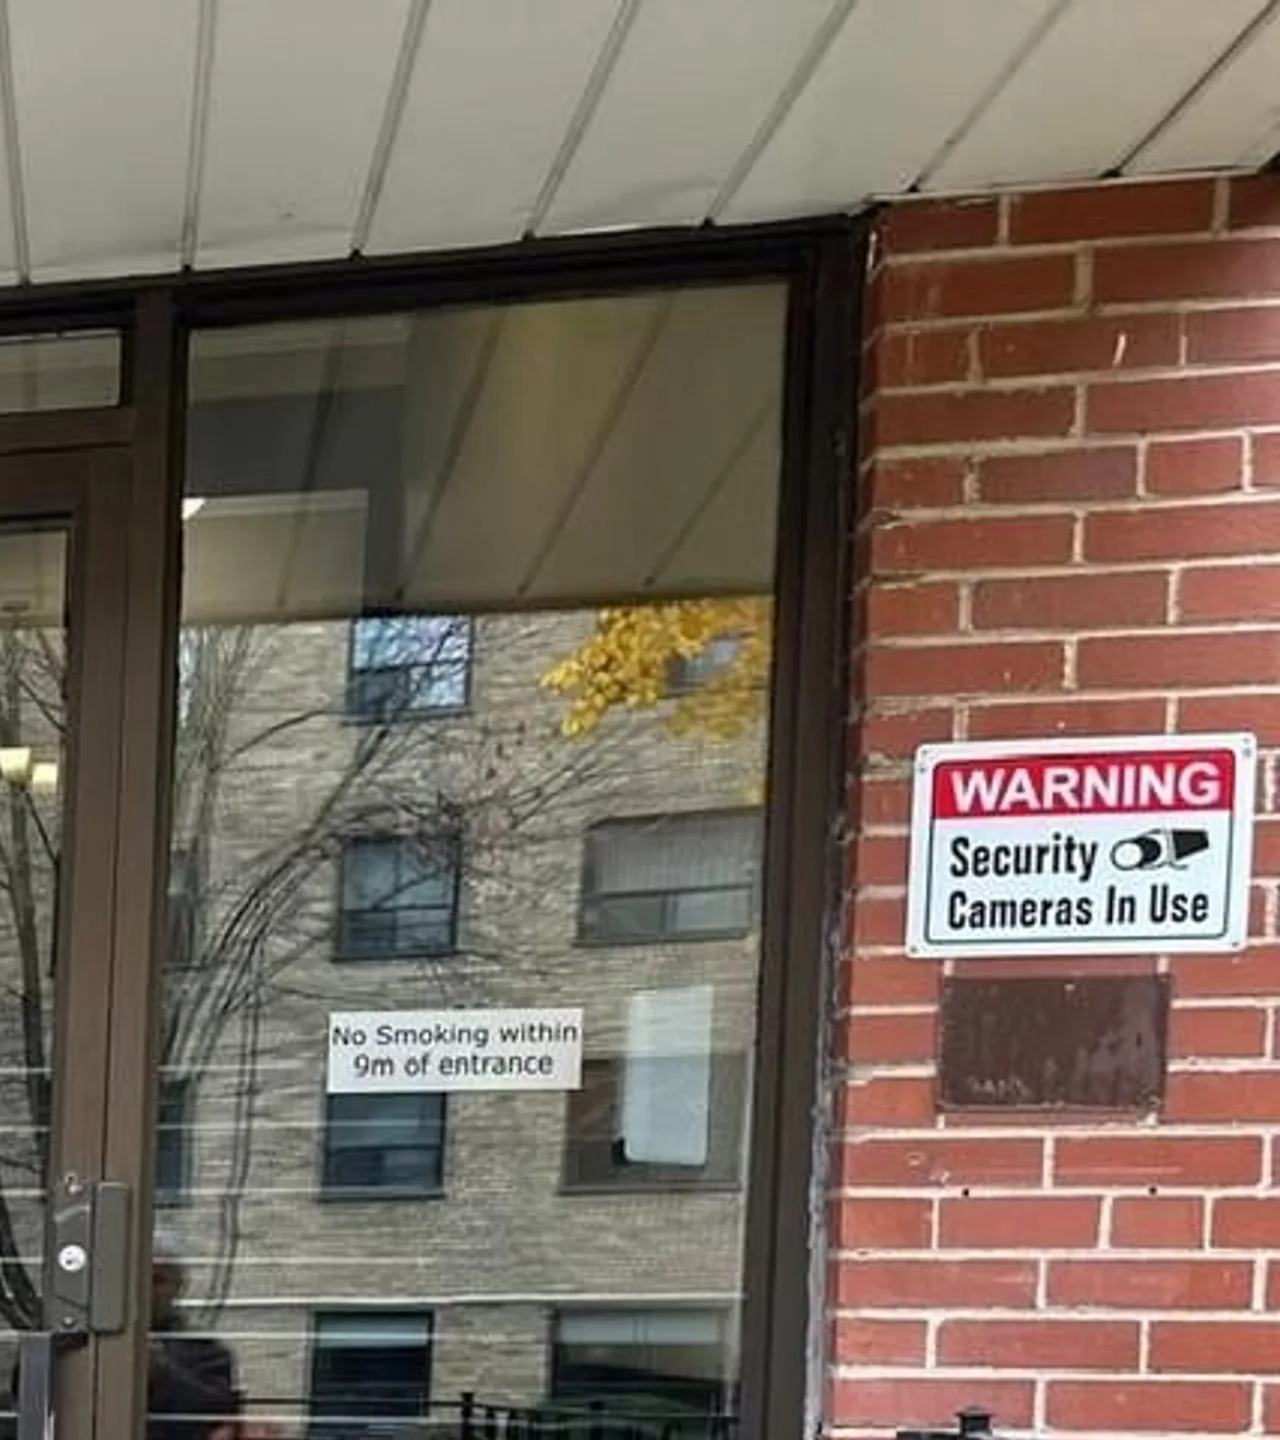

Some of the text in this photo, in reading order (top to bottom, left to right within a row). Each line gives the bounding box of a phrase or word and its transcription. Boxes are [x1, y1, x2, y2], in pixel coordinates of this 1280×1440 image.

[950, 761, 1223, 813] WARNING
[949, 831, 1099, 882] Security
[947, 884, 1210, 931] Cameras In Use
[332, 1022, 579, 1049] No Smoking within
[353, 1053, 554, 1077] 9m of entrance
